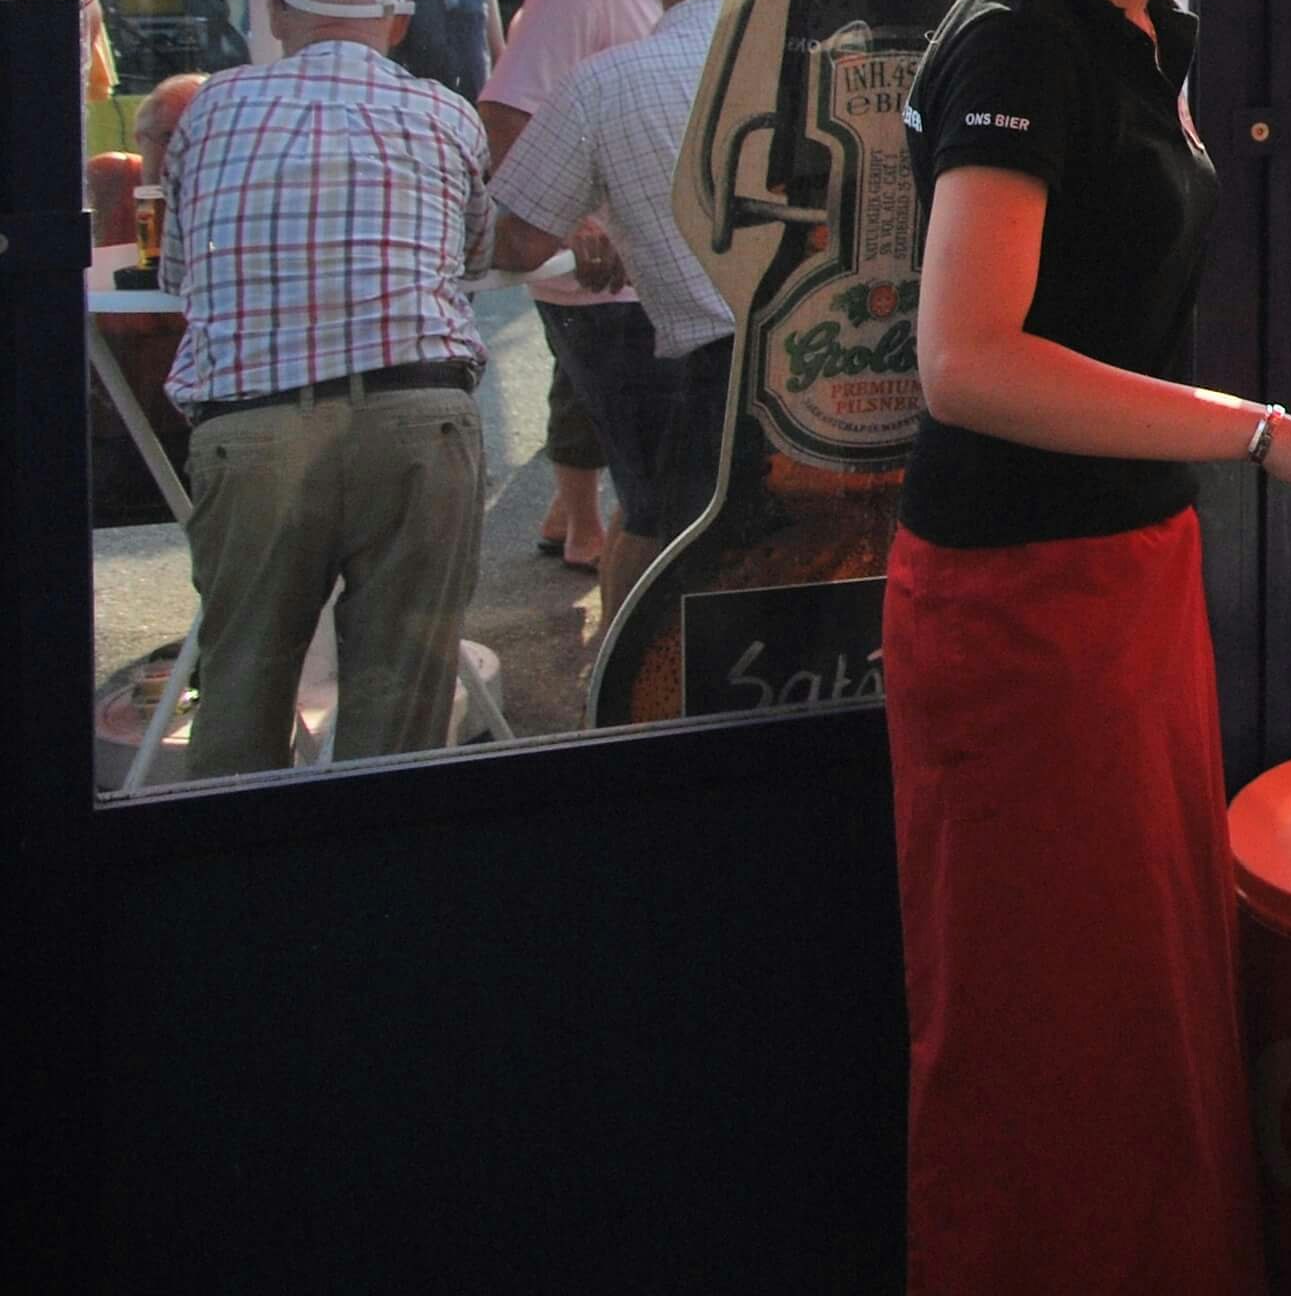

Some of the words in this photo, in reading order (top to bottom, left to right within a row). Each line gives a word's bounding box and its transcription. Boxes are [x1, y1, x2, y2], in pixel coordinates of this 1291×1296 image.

[965, 112, 991, 126] ONS
[995, 113, 1030, 131] BIER
[784, 320, 918, 393] Grols
[836, 395, 921, 414] PILSNER
